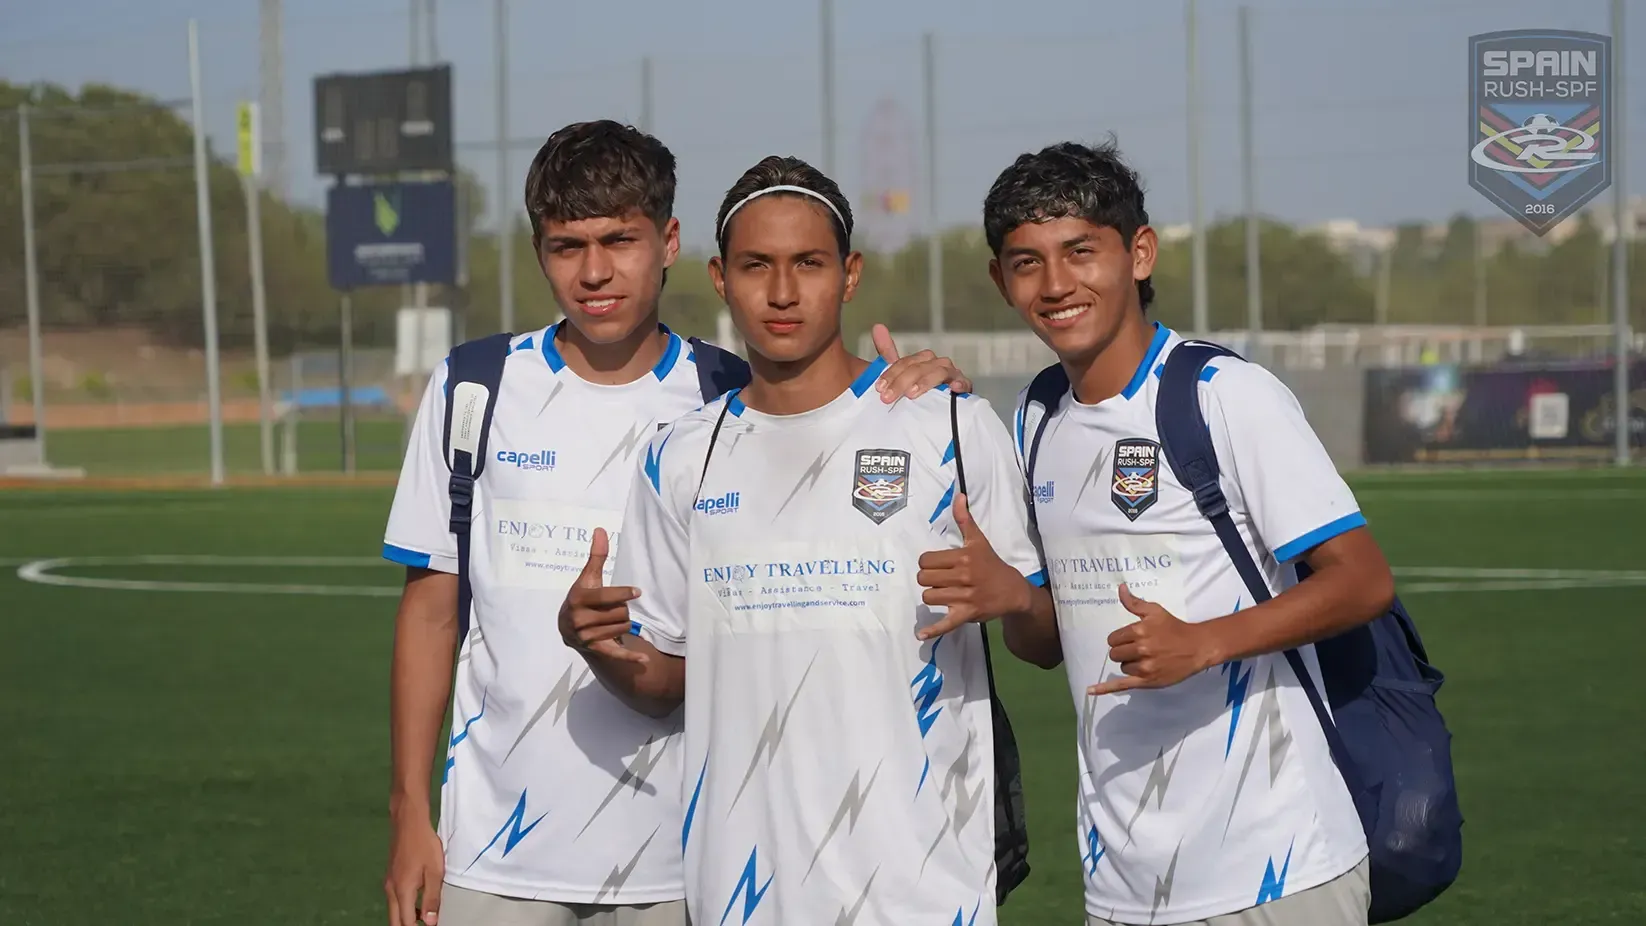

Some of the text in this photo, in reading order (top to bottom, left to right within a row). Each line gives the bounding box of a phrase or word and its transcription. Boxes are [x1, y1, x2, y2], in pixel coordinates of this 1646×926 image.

[1118, 445, 1155, 457] SPAIN
[496, 450, 556, 467] capelli
[860, 455, 906, 466] SPAIN
[1117, 458, 1155, 467] RUSH-SPF
[522, 464, 555, 472] SPORT
[860, 466, 905, 474] RUSH-SPF
[692, 492, 740, 514] apelli
[709, 507, 738, 515] SPORT
[760, 584, 823, 595] Assistance
[842, 583, 880, 592] Travel
